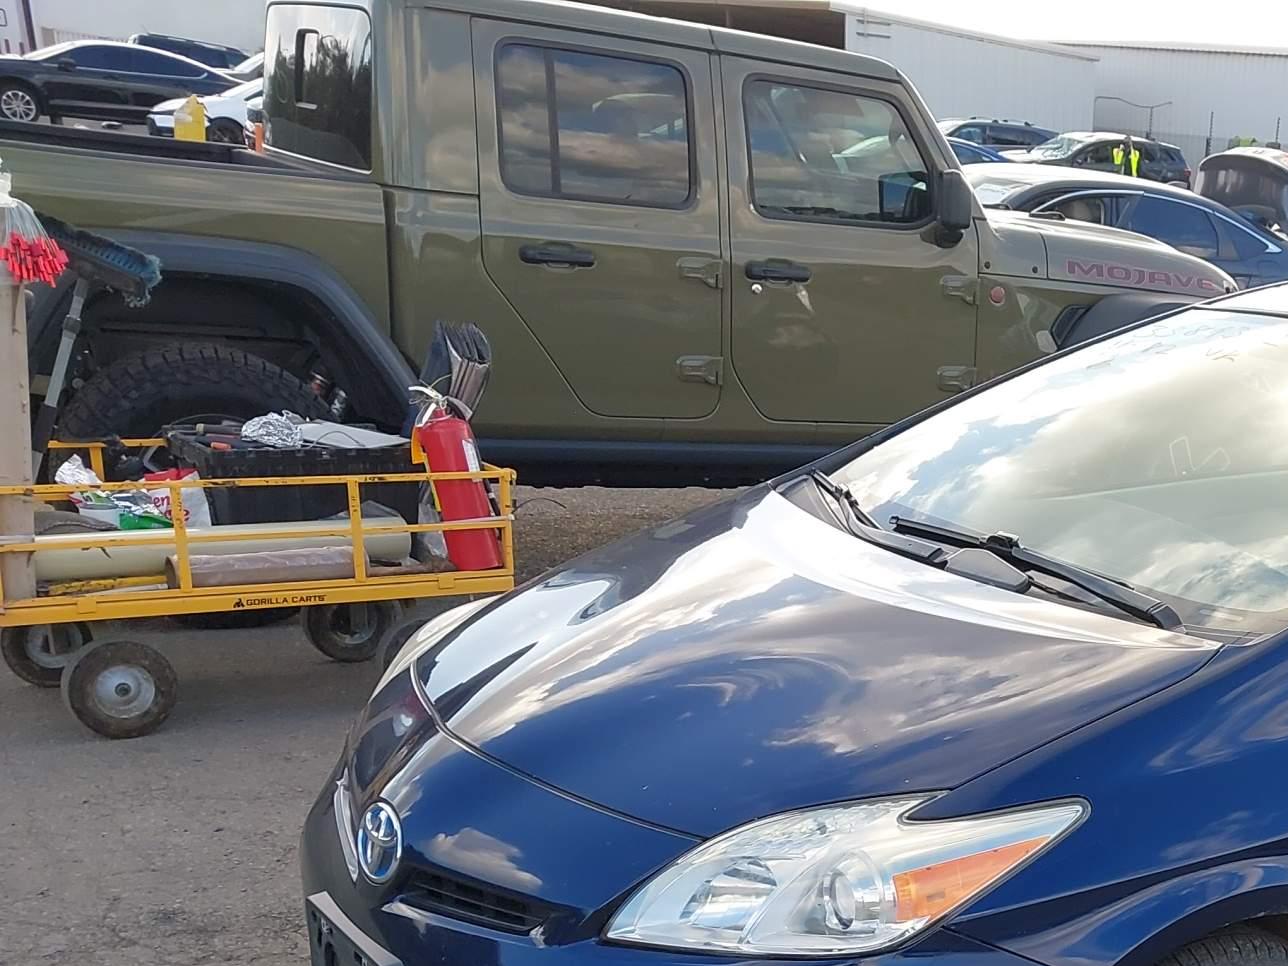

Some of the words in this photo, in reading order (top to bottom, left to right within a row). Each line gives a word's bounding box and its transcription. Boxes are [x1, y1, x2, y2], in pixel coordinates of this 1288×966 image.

[1067, 260, 1217, 292] MOJAVE
[246, 597, 288, 606] GORILLA
[291, 594, 325, 603] CARTS
